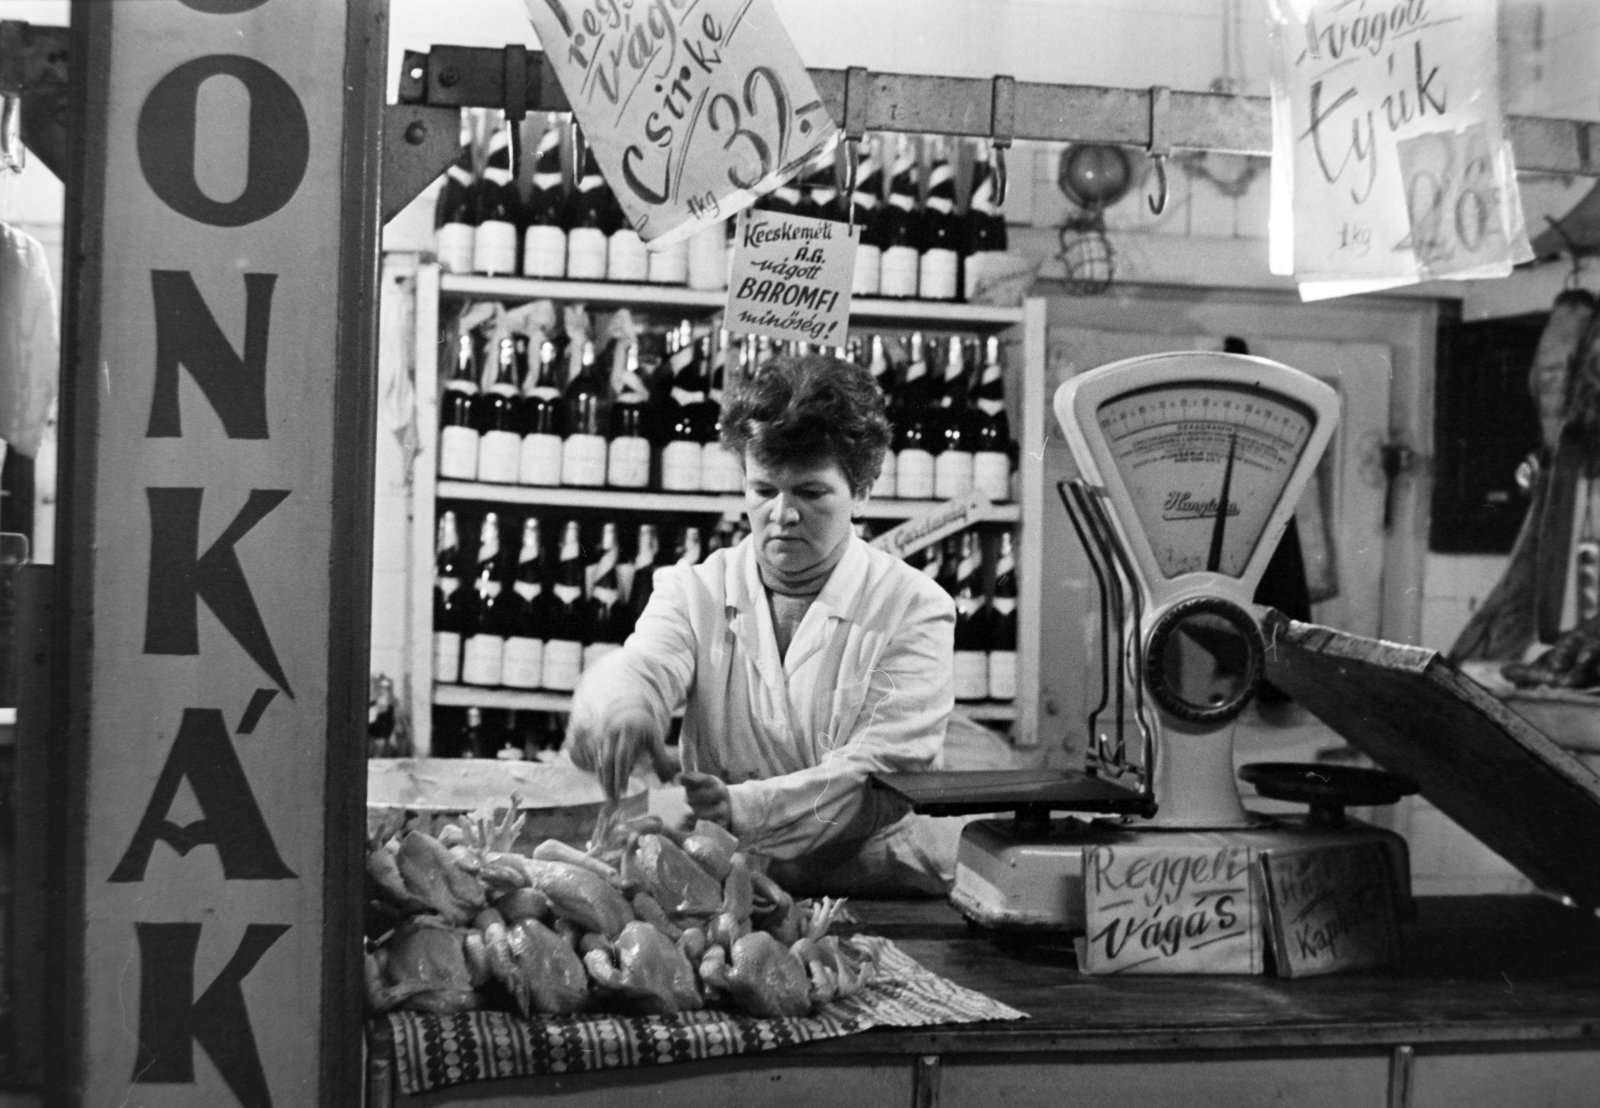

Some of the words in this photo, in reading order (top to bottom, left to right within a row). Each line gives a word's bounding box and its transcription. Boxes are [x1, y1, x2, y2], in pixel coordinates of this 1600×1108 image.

[622, 13, 723, 205] Csirke
[751, 257, 822, 281] vágott
[736, 277, 839, 313] BAROMFI
[739, 310, 839, 340] minőség!
[106, 0, 310, 1108] ONKÁK
[1088, 845, 1250, 908] Reggeli
